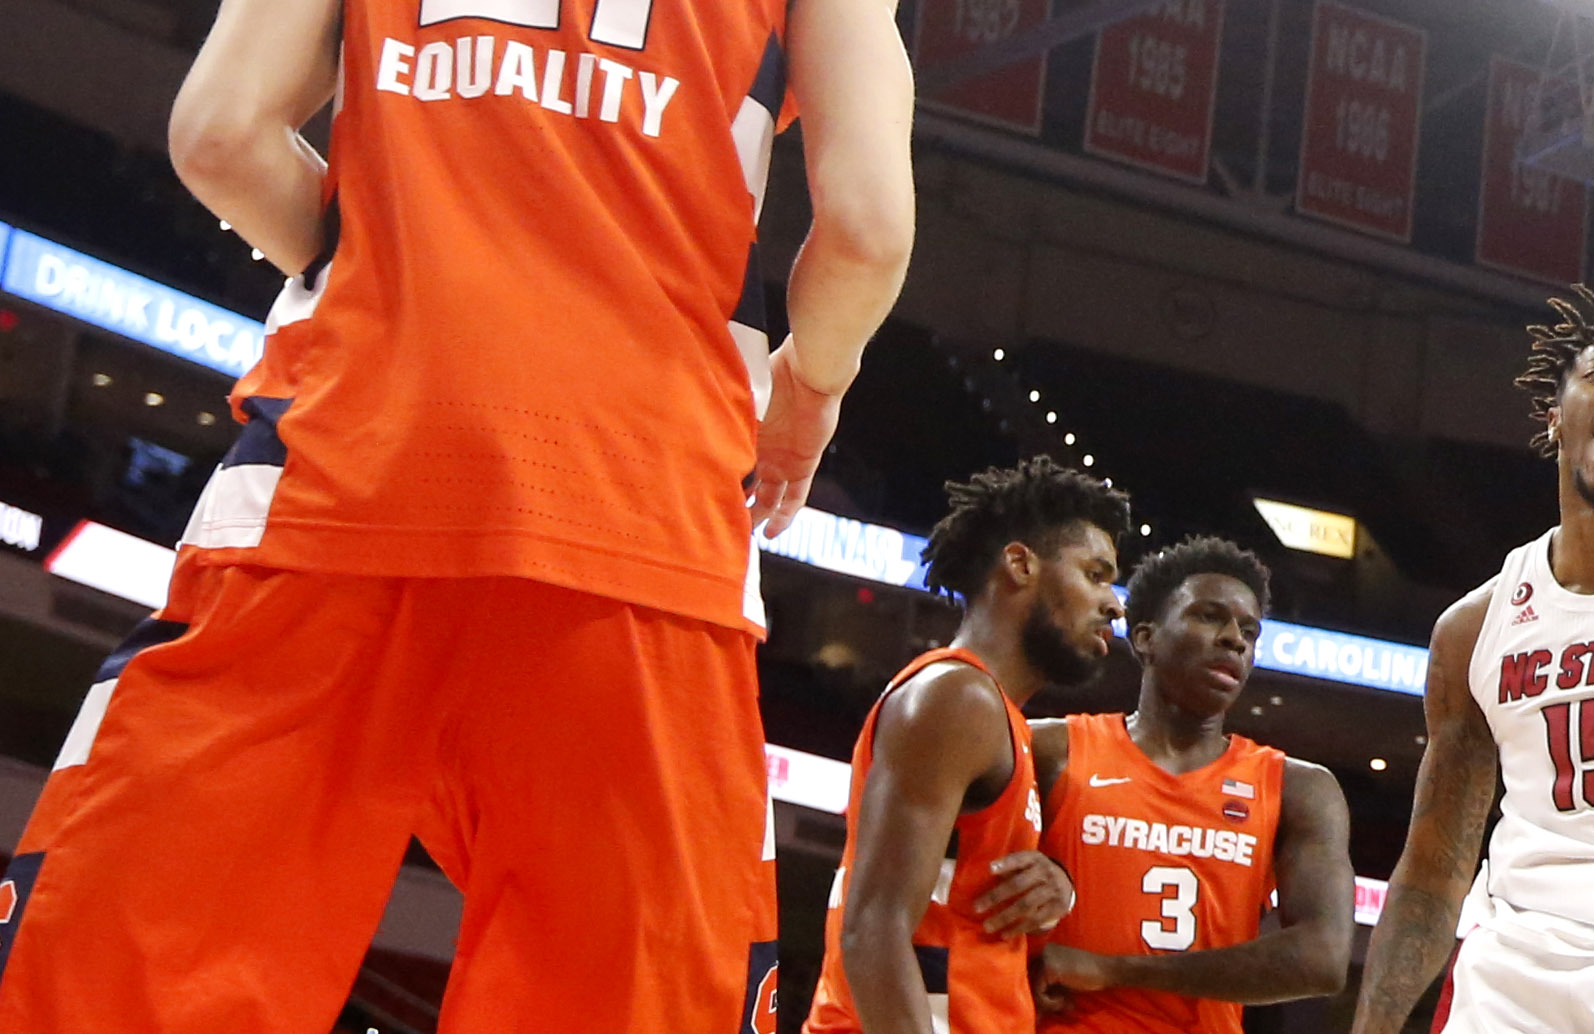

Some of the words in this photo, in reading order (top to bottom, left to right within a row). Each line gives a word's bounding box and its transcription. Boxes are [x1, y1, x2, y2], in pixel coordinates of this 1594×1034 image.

[376, 35, 680, 138] EQUALITY
[35, 253, 153, 332] DRINK
[155, 299, 263, 371] LOCA
[1499, 649, 1553, 705] NC
[1081, 814, 1257, 867] SYRACUSE
[1140, 866, 1199, 952] 3
